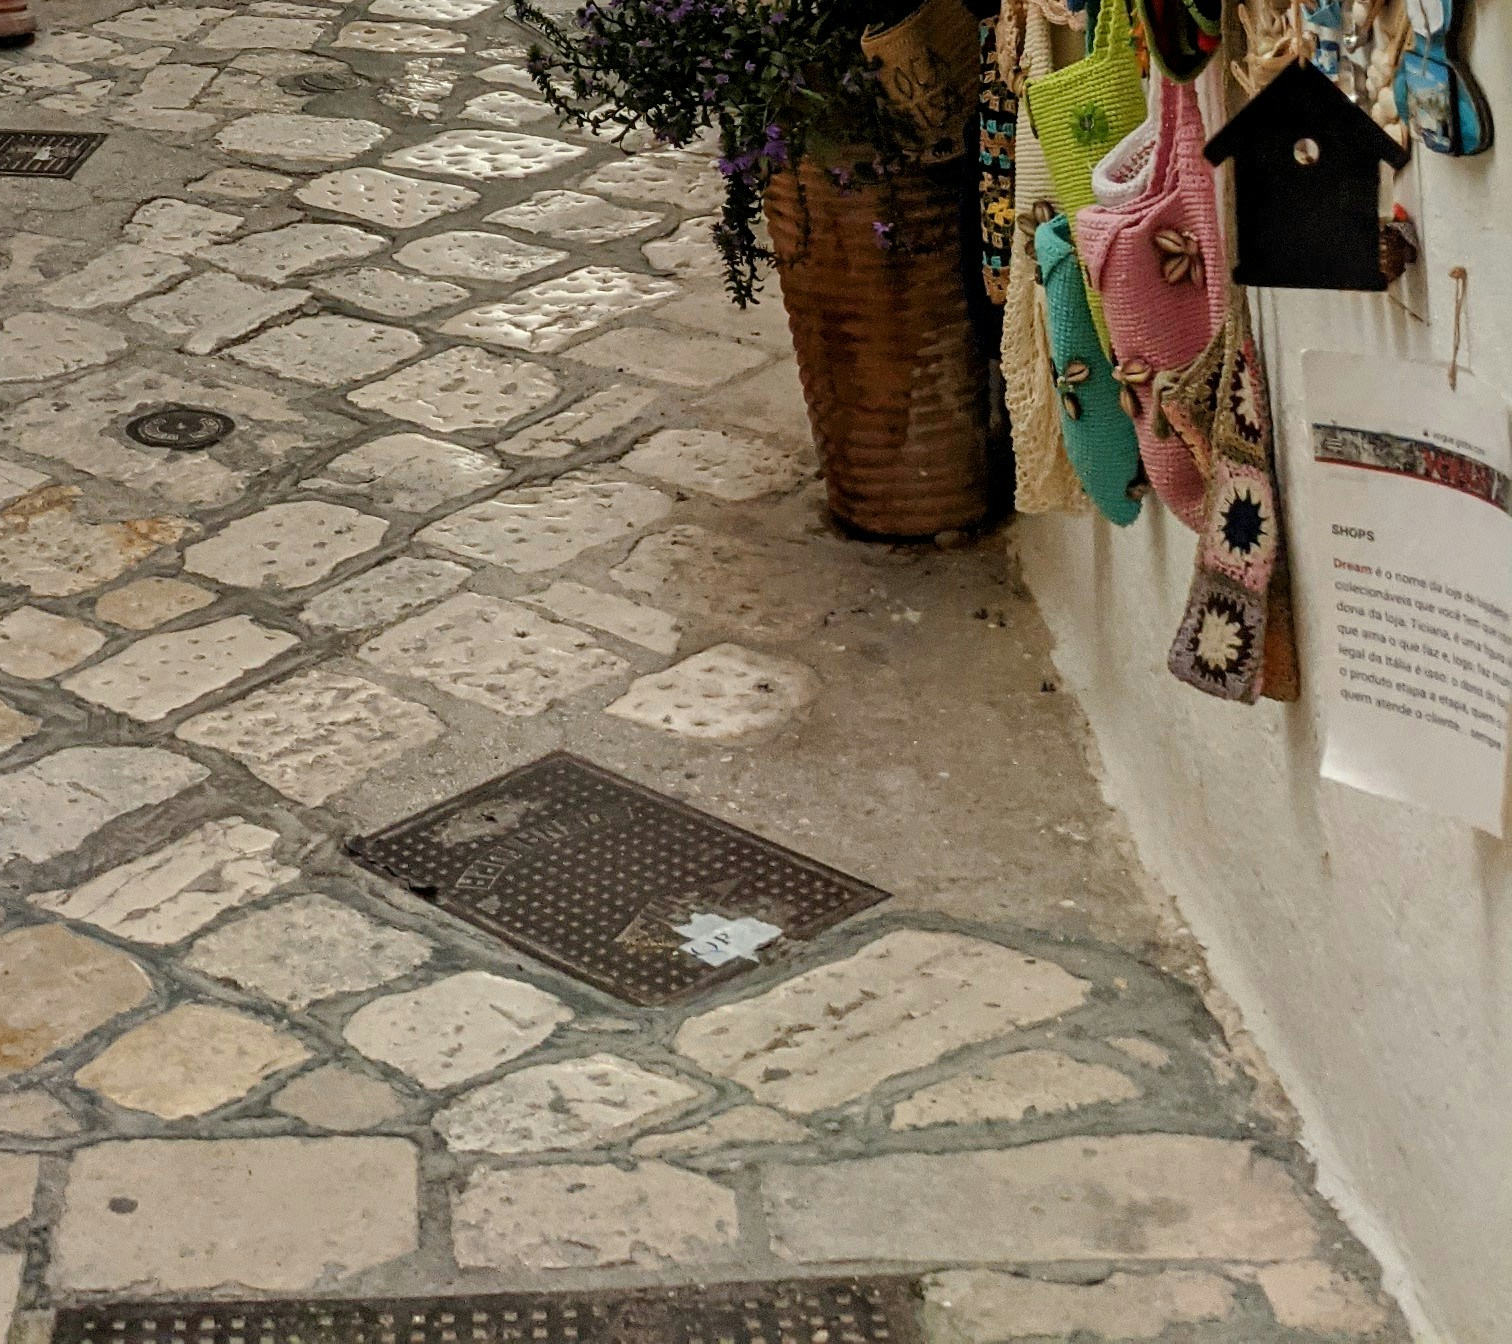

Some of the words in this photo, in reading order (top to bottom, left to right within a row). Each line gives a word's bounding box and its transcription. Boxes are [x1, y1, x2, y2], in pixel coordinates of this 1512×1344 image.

[1331, 523, 1376, 542] SHOPS
[1333, 556, 1373, 575] Dream
[1384, 570, 1393, 580] o
[1349, 669, 1393, 689] produto
[1340, 688, 1372, 705] quem
